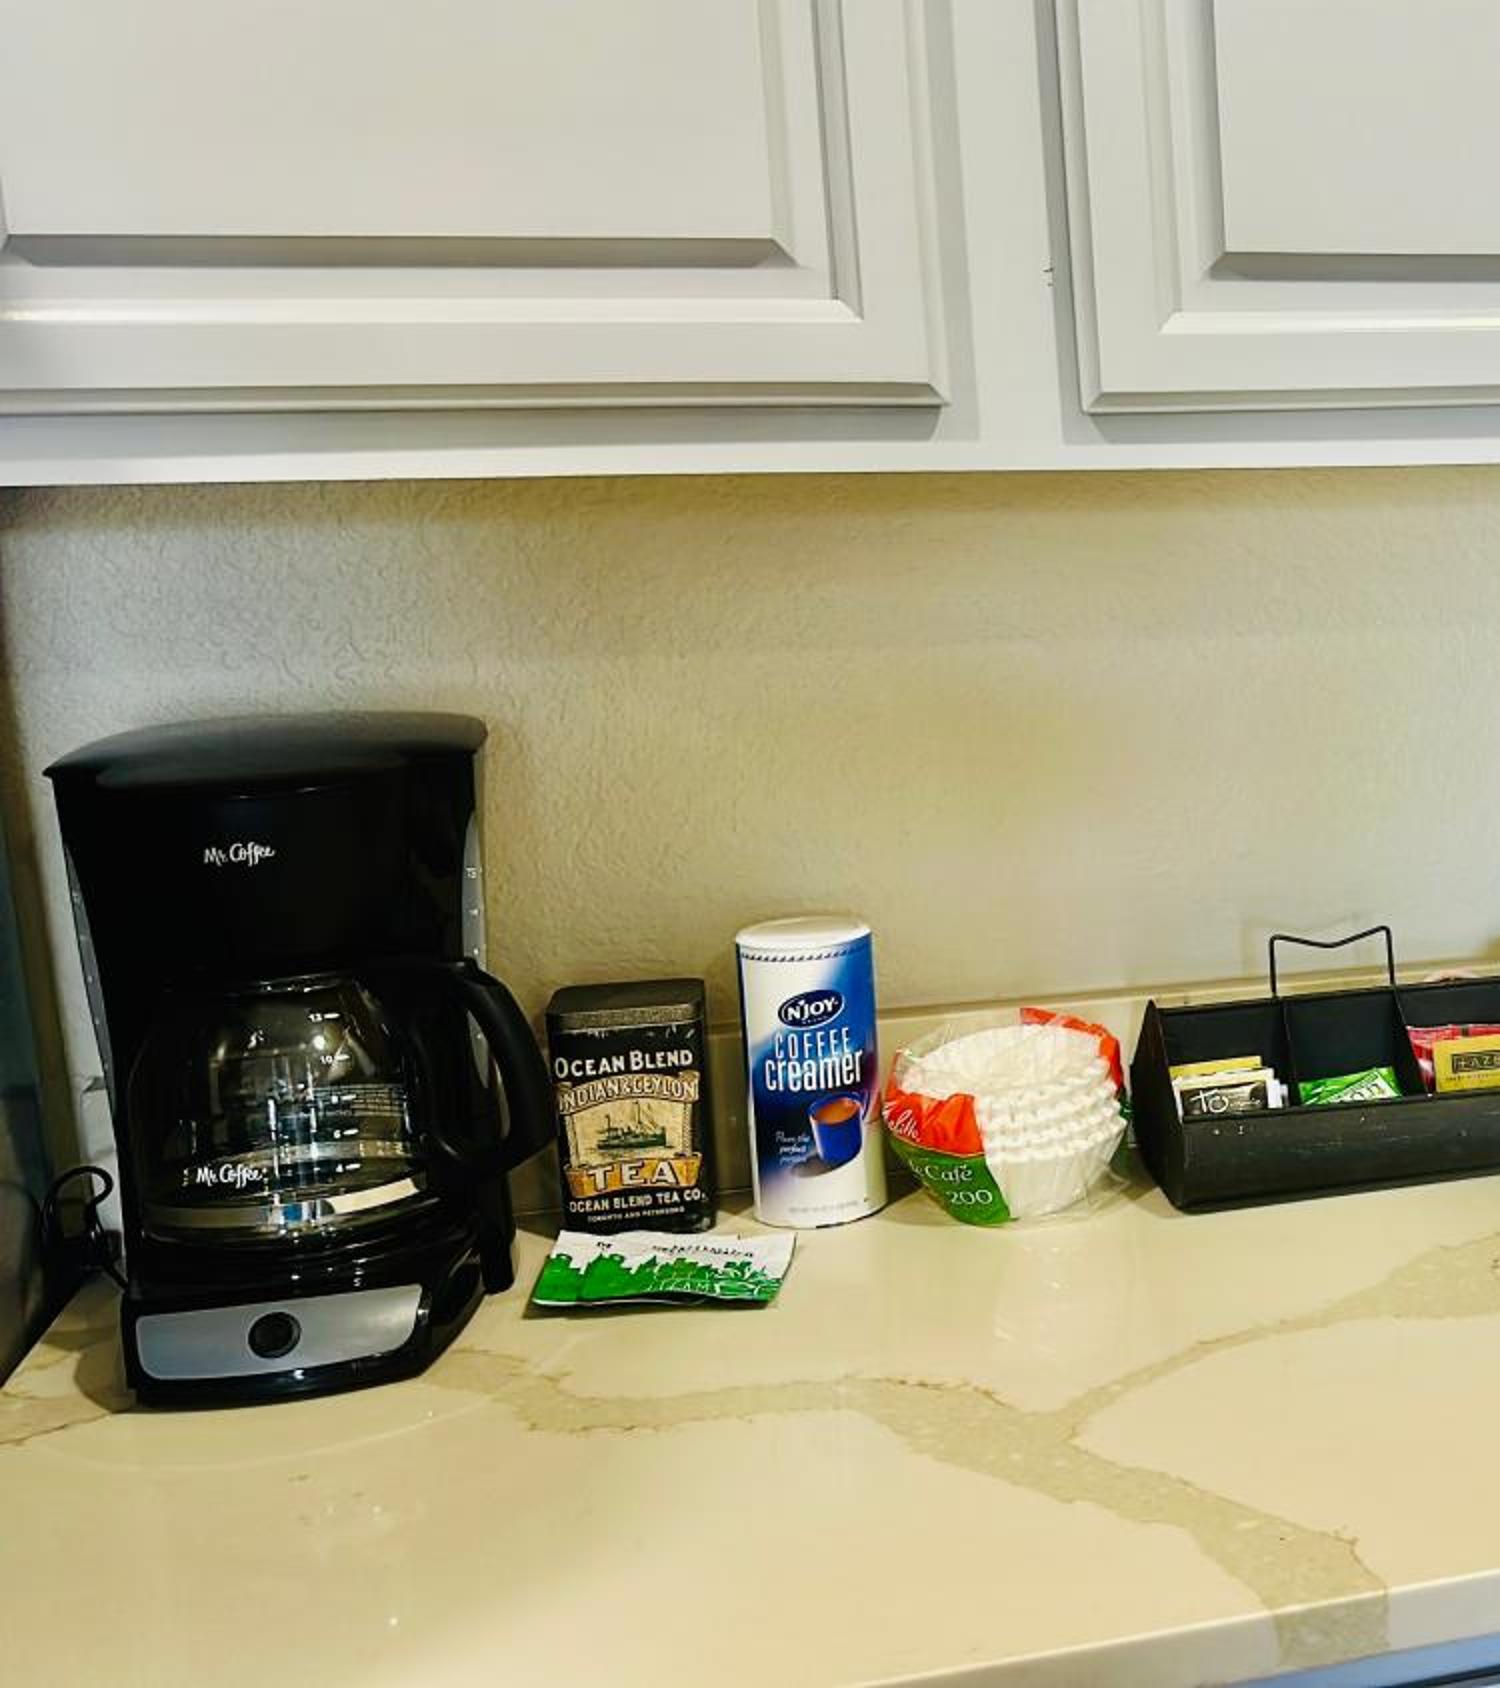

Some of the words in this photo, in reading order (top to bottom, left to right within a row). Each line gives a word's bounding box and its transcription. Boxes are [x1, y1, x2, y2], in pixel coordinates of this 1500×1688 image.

[229, 841, 276, 867] Coffee
[775, 1027, 849, 1059] COFFEE
[555, 1056, 626, 1079] OCEAN
[629, 1049, 693, 1071] BLEND
[765, 1050, 863, 1092] creamer
[219, 1163, 262, 1189] Coffee
[588, 1161, 677, 1191] TEA
[569, 1200, 610, 1214] OCEAN
[613, 1195, 652, 1209] BLEND
[655, 1190, 680, 1203] TEA
[947, 1189, 993, 1205] 200
